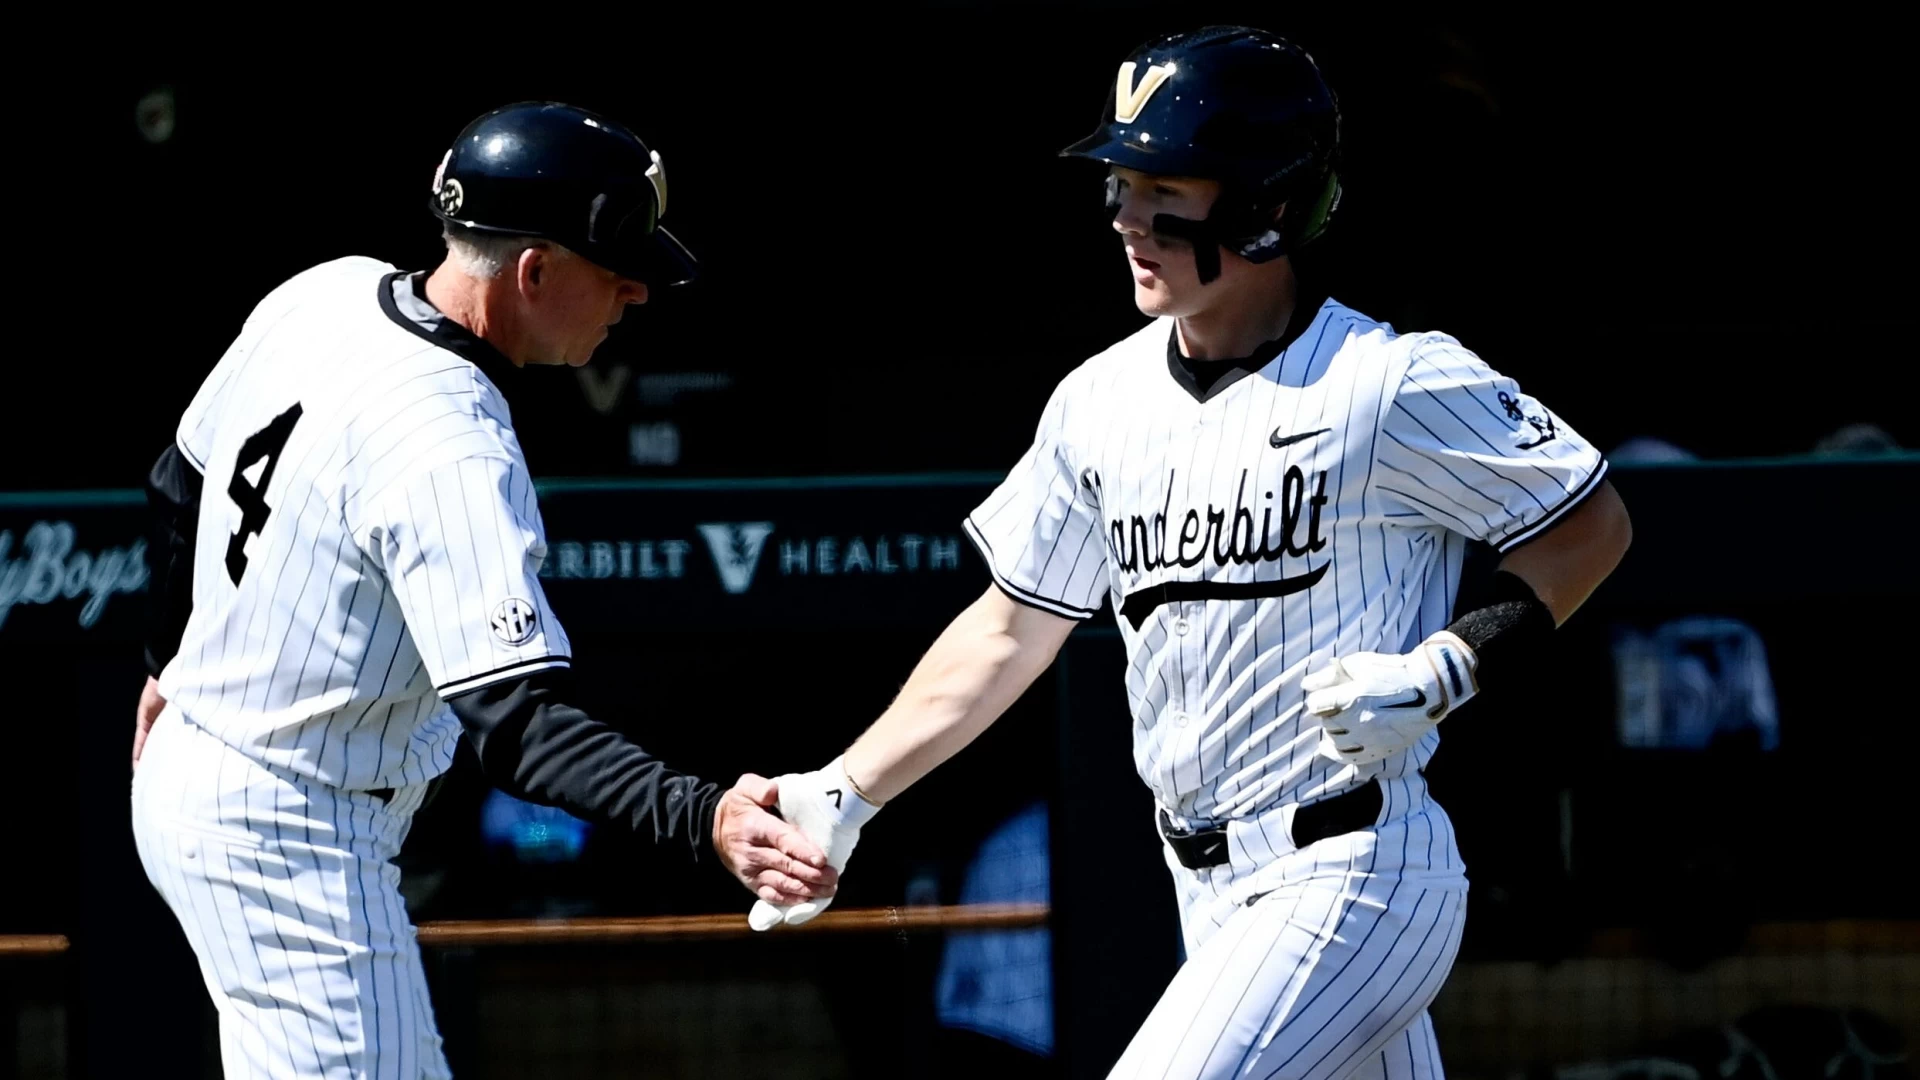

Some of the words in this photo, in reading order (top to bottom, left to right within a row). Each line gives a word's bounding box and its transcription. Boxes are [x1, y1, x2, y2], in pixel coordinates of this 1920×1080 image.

[1115, 61, 1177, 124] V
[225, 400, 303, 589] 4
[779, 535, 961, 576] HEALTH
[491, 598, 537, 644] SEC
